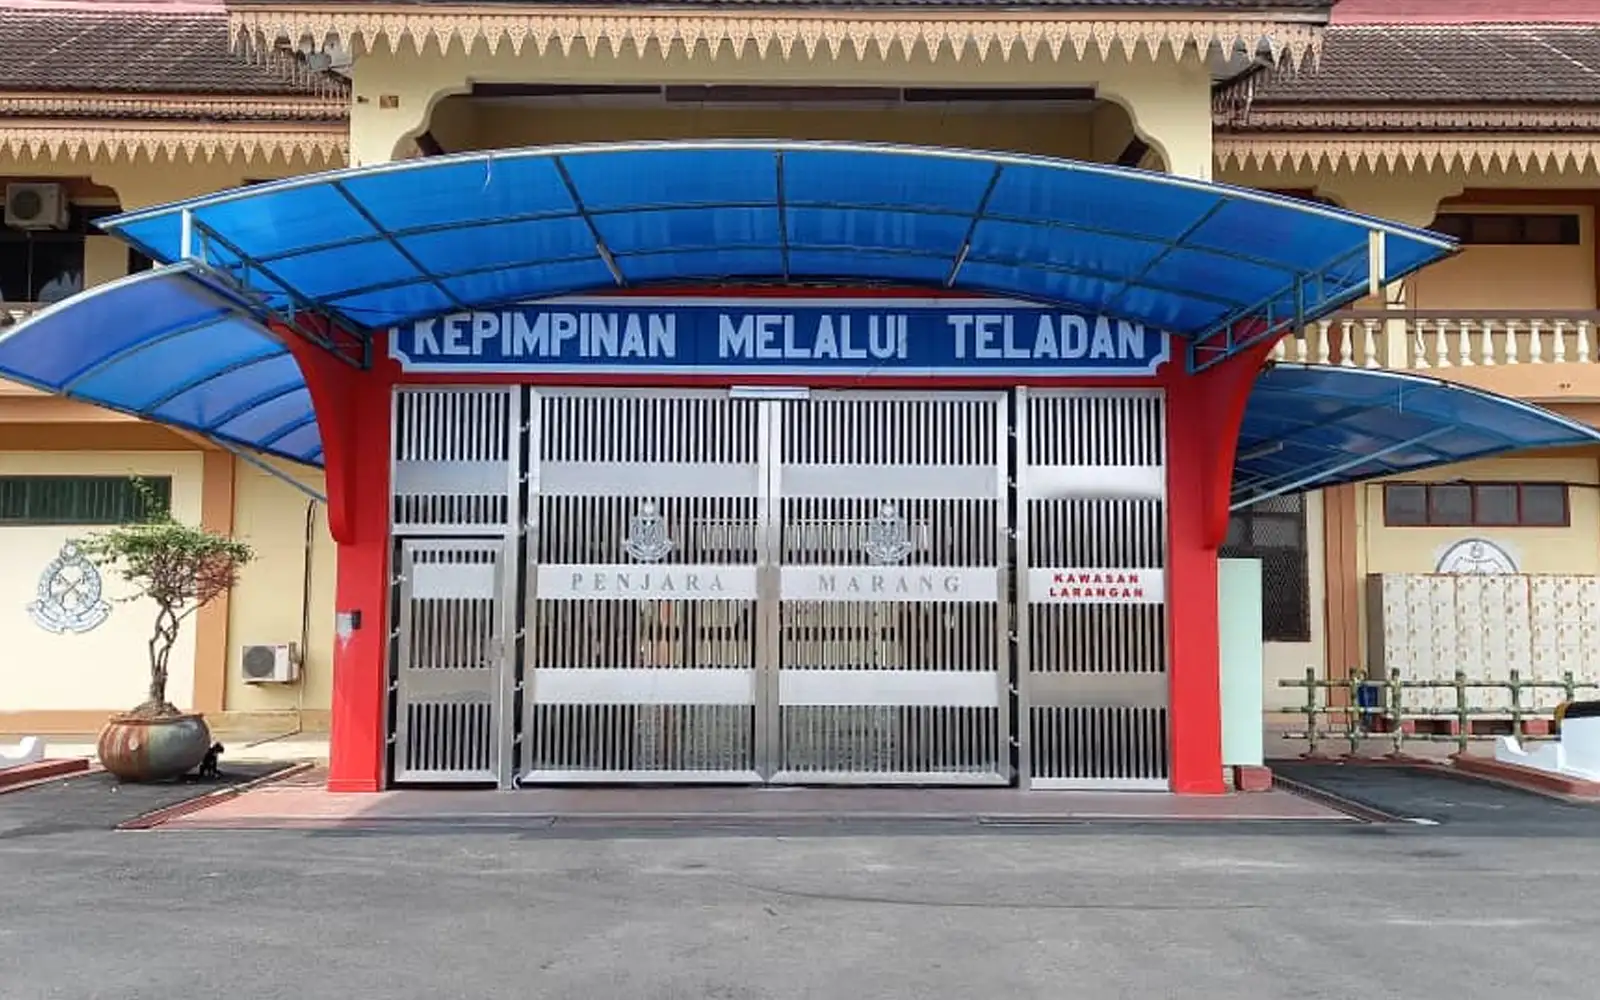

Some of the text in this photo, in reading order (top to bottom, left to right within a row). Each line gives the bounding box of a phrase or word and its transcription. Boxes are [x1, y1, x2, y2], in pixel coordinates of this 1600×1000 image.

[413, 312, 1145, 360] KEPIMPINAN MELALUI TELADAN
[571, 573, 960, 593] PENJARA MARANG
[1053, 573, 1139, 584] KAWASAN
[1049, 587, 1143, 598] LARANGAN
